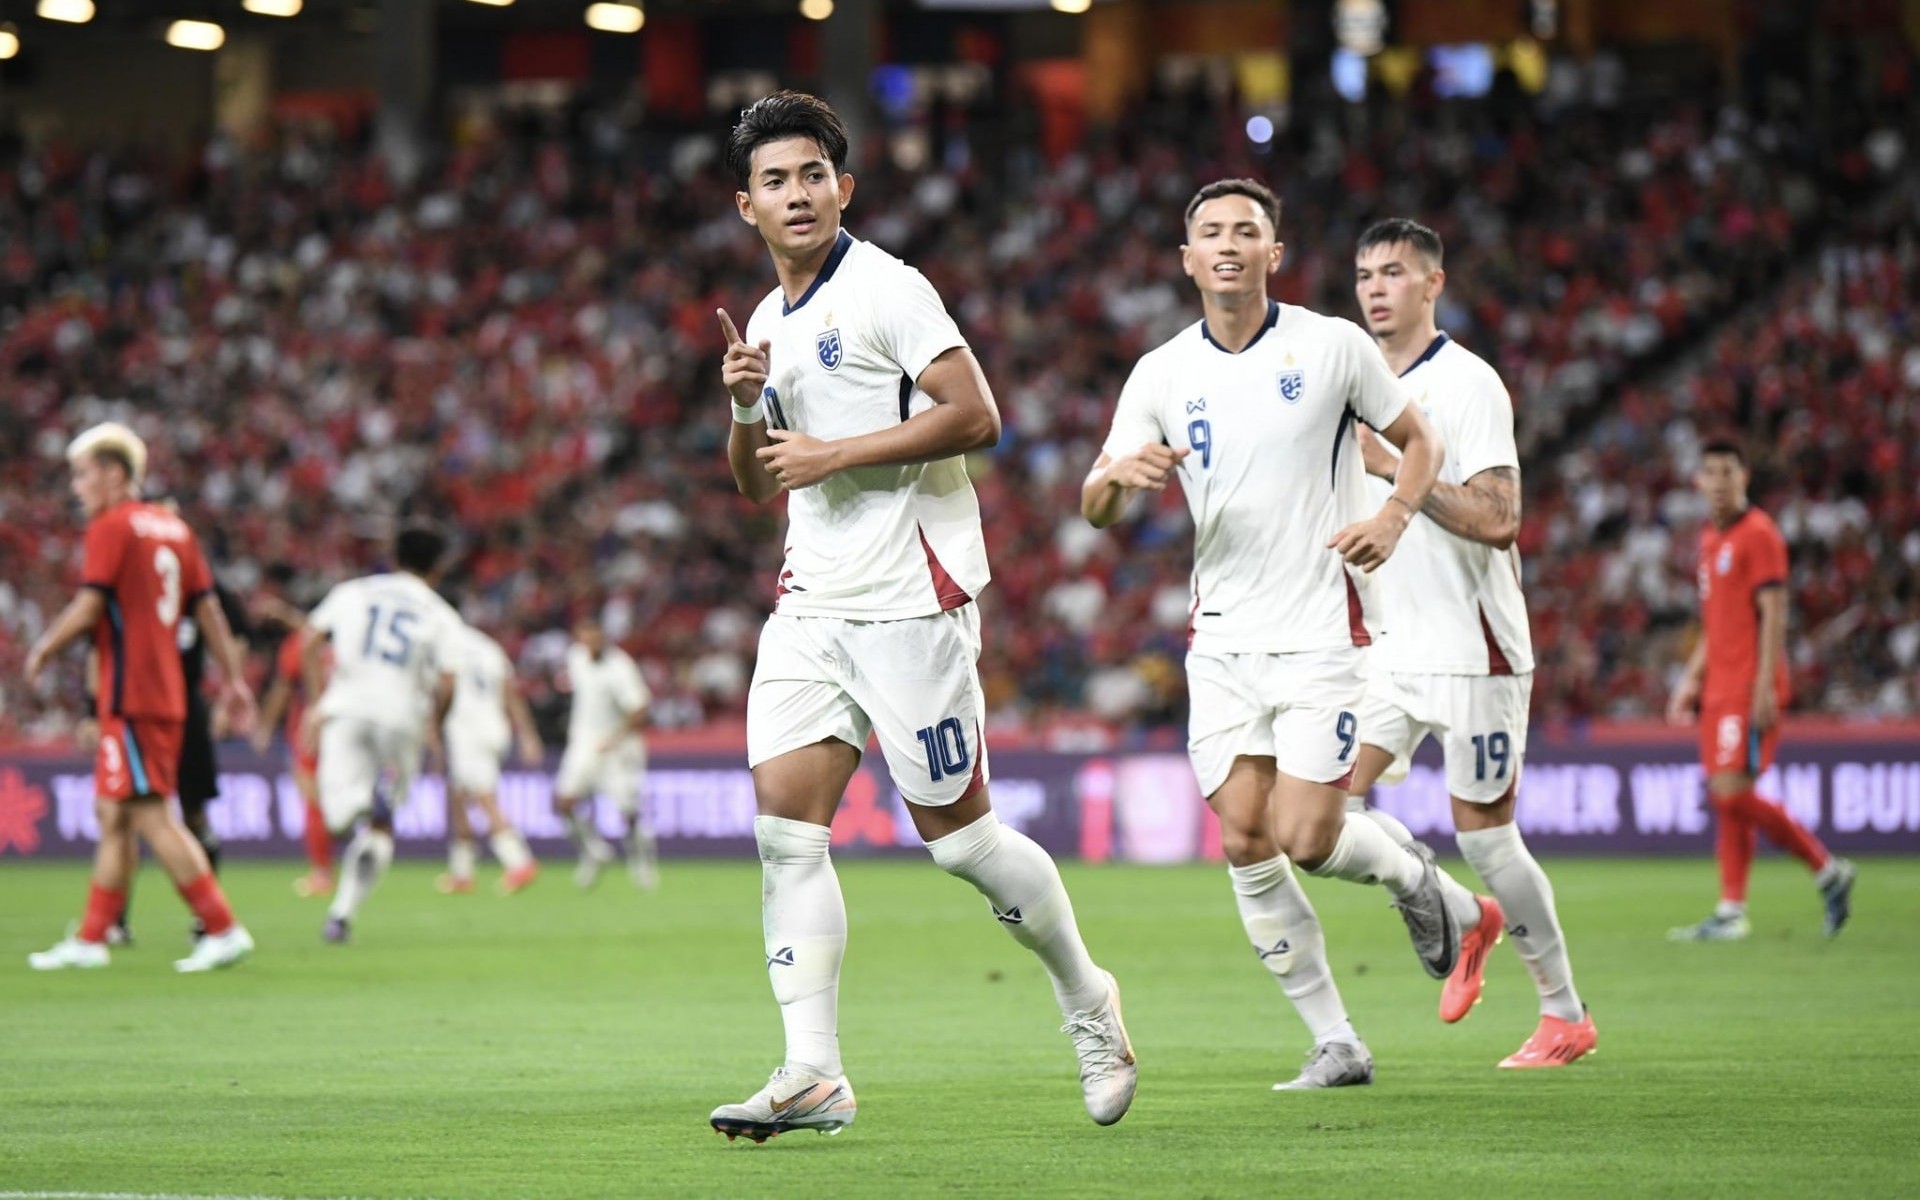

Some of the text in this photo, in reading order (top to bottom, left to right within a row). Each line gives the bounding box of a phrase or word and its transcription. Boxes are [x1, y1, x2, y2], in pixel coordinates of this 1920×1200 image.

[1188, 419, 1211, 469] 9
[154, 545, 181, 626] 3
[363, 605, 420, 667] 15
[916, 717, 969, 782] 10
[1336, 711, 1357, 761] 9
[1471, 732, 1510, 781] 19
[1630, 763, 1708, 834] WE
